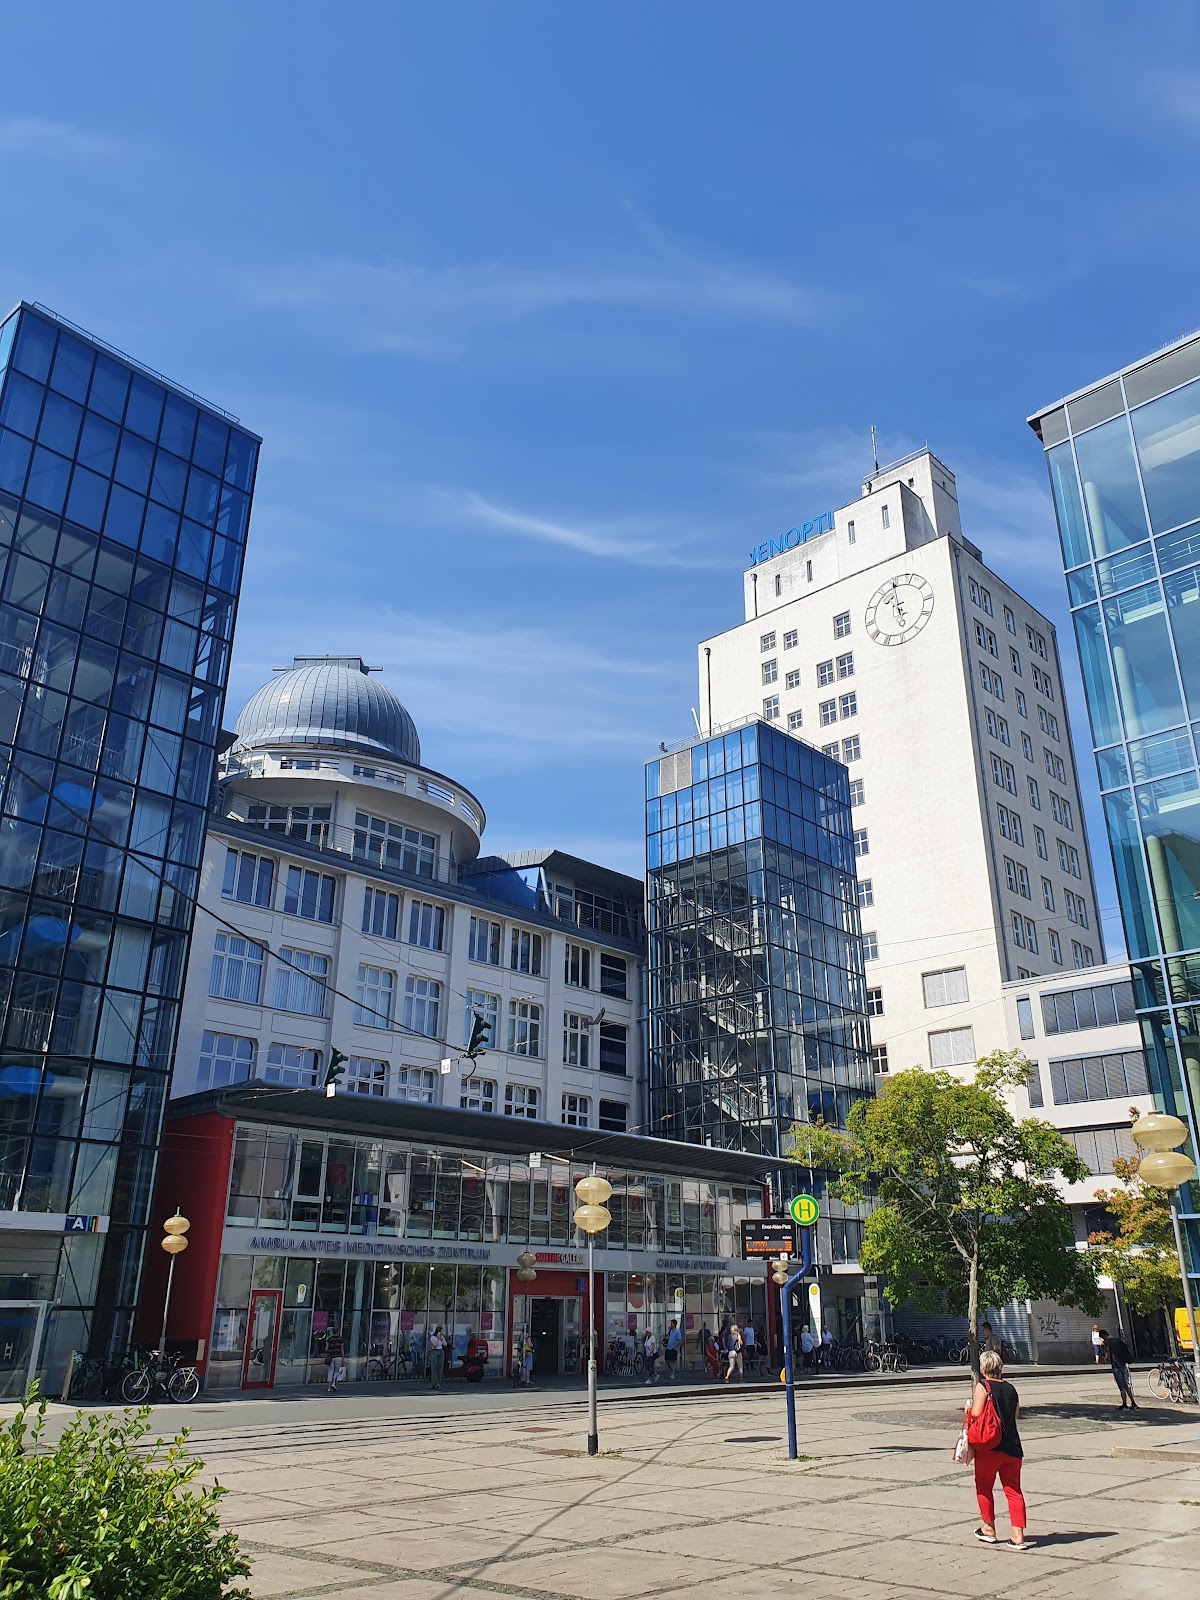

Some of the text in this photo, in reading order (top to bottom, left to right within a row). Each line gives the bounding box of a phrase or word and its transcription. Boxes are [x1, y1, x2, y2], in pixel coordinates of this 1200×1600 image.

[749, 506, 842, 568] JENOPTI
[799, 1202, 811, 1218] H
[72, 1217, 84, 1229] A
[249, 1236, 341, 1253] AMBULANTES
